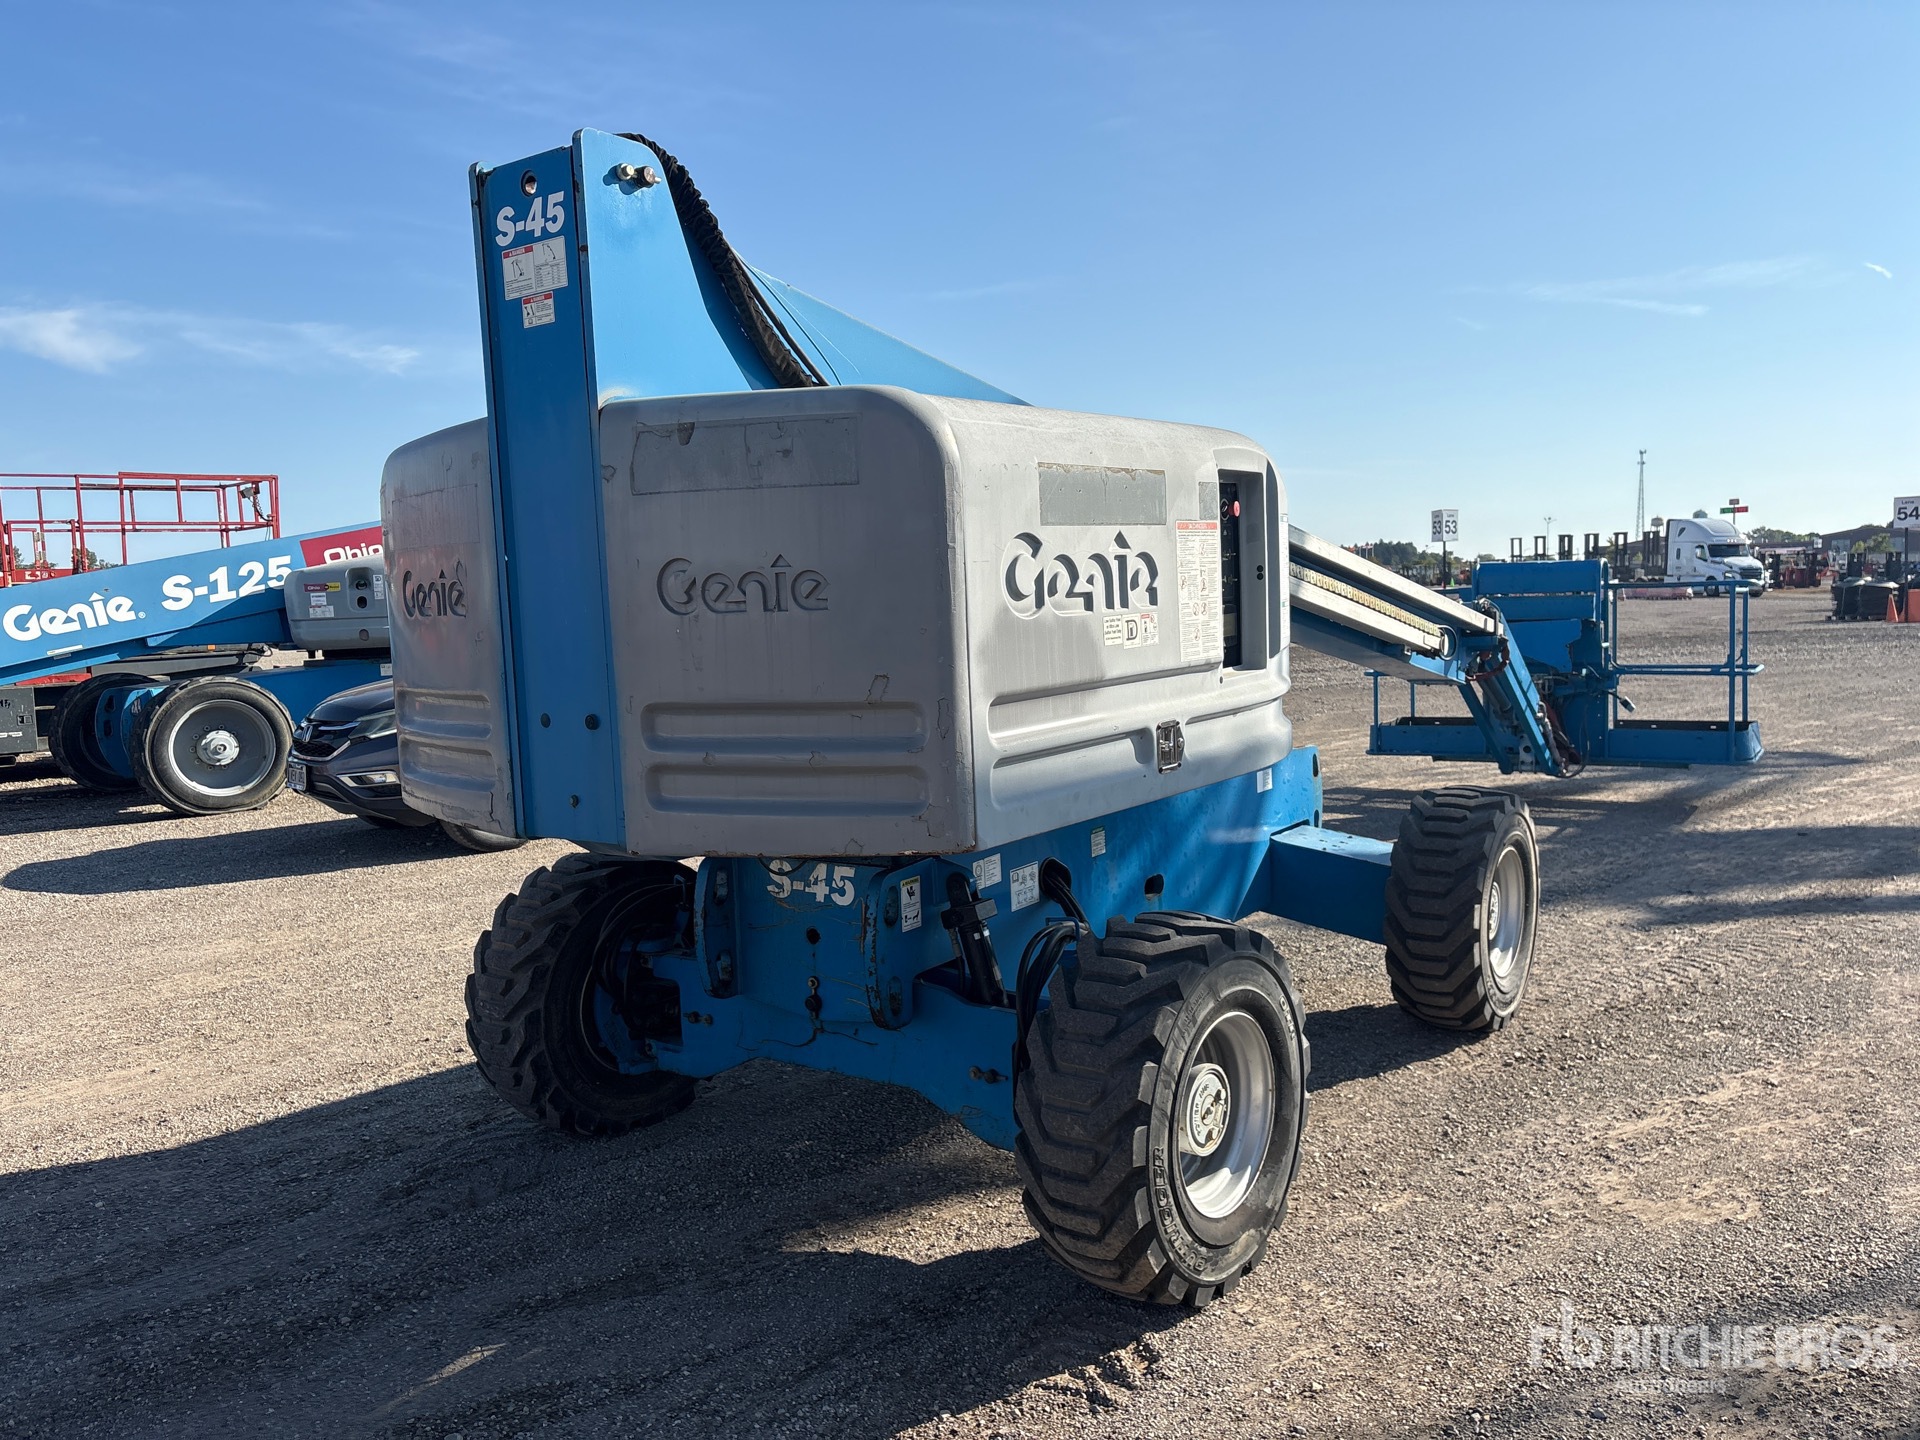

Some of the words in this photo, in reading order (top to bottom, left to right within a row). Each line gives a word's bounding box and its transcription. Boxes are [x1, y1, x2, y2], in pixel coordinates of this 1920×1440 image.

[495, 191, 565, 247] S-45
[1432, 520, 1442, 535] 53
[1444, 520, 1458, 535] 53
[1896, 506, 1920, 521] 54
[3, 592, 137, 641] Genie
[161, 555, 293, 611] S-125
[402, 569, 467, 619] Genie
[657, 554, 830, 616] Genie
[1001, 530, 1159, 619] Genie
[767, 859, 856, 906] S-45
